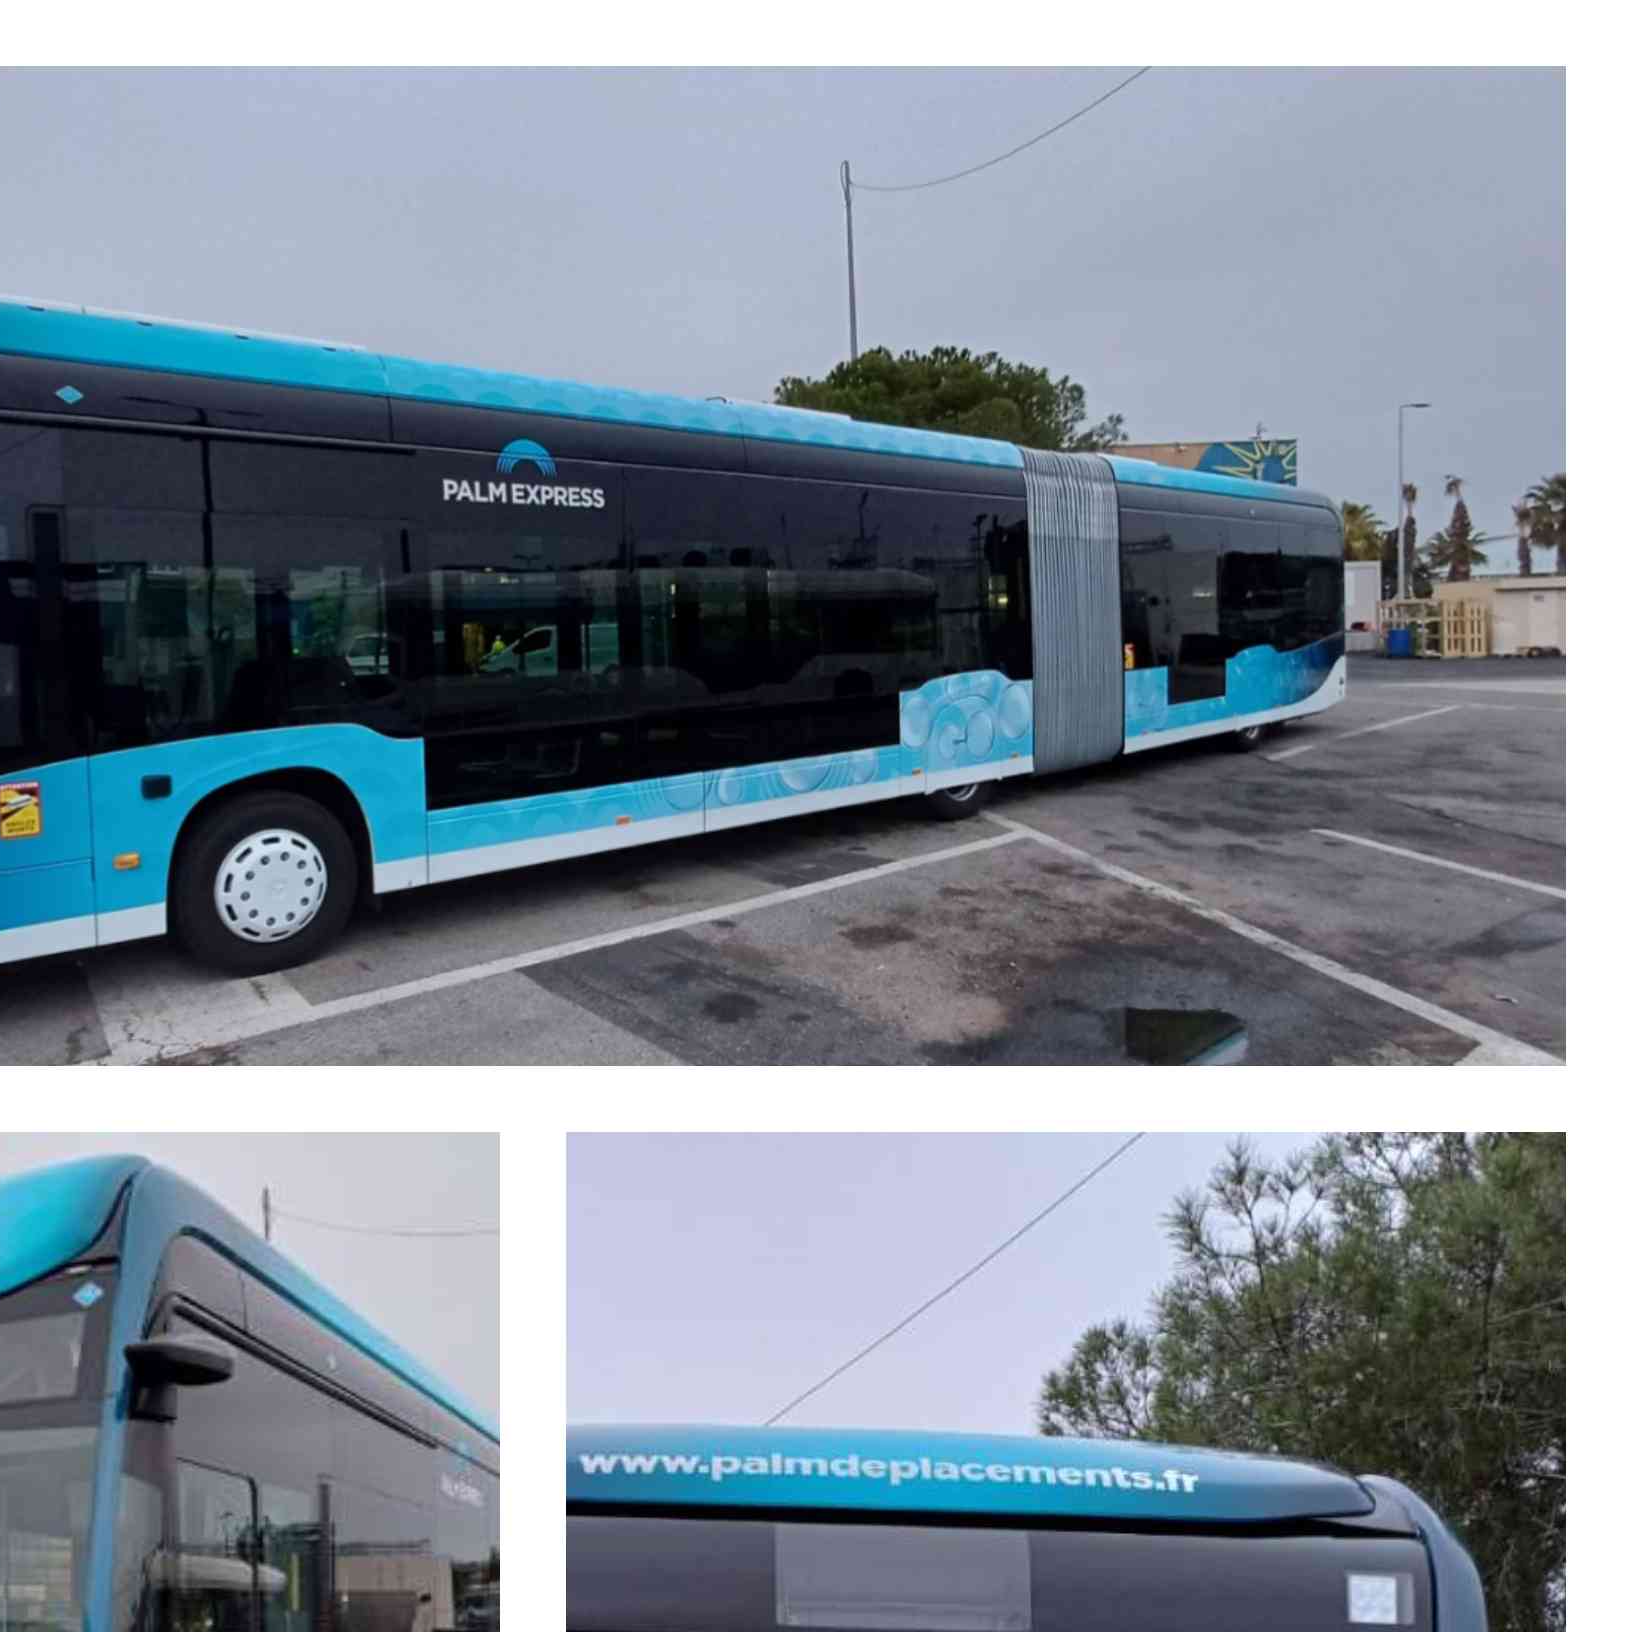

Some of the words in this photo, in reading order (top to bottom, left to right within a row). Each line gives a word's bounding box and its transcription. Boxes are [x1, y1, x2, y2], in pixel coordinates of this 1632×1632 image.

[442, 478, 507, 504] PALM
[511, 483, 605, 509] EXPRESS
[579, 1450, 1199, 1493] www.palmdeplacements.fr
